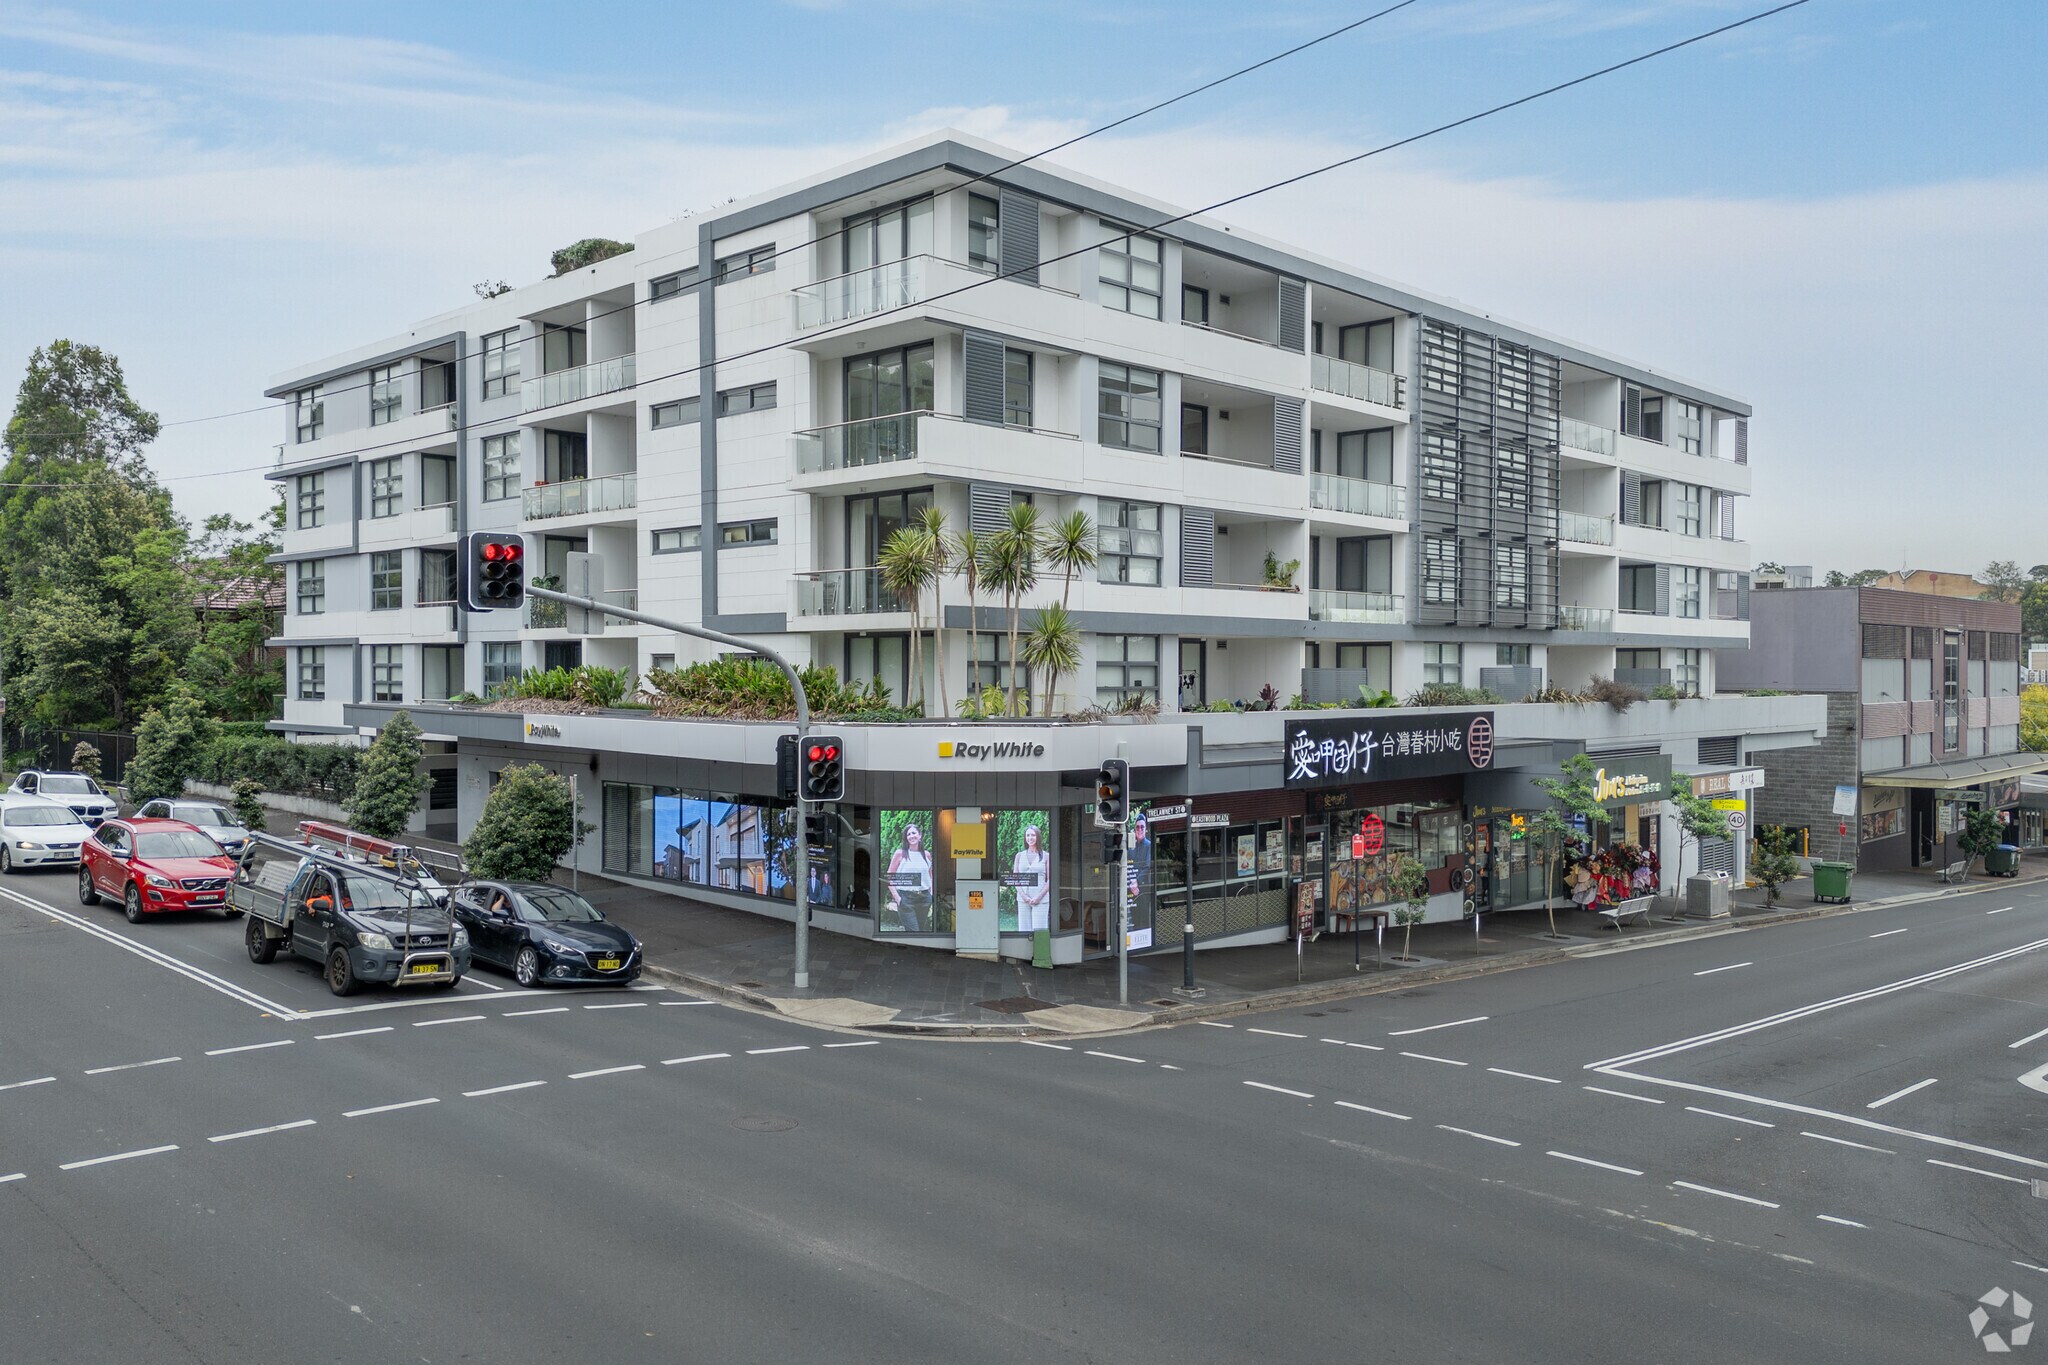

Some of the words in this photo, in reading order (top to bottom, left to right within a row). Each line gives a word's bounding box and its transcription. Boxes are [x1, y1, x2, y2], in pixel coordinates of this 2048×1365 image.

[1381, 727, 1462, 757] 台灣眷村小吃
[1731, 816, 1743, 824] 40
